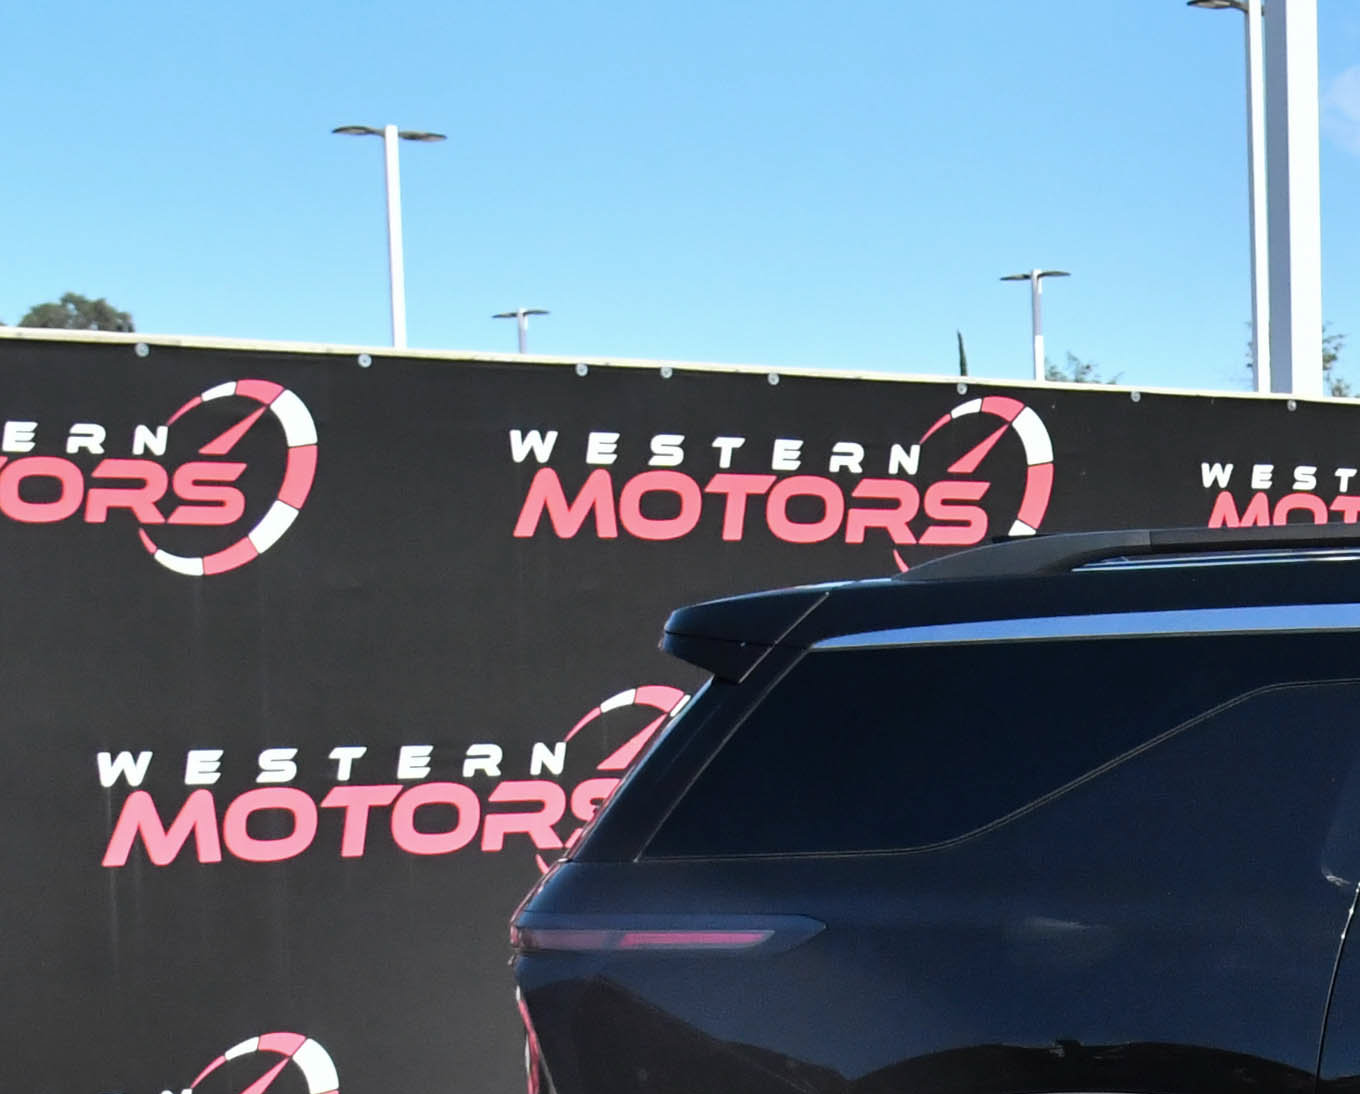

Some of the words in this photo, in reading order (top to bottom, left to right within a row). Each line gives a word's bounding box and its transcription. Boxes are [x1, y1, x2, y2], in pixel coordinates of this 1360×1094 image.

[2, 421, 168, 455] ERN
[509, 429, 921, 475] WESTERN
[0, 456, 247, 526] ORS
[513, 467, 991, 545] MOTORS
[97, 741, 567, 787] WESTERN
